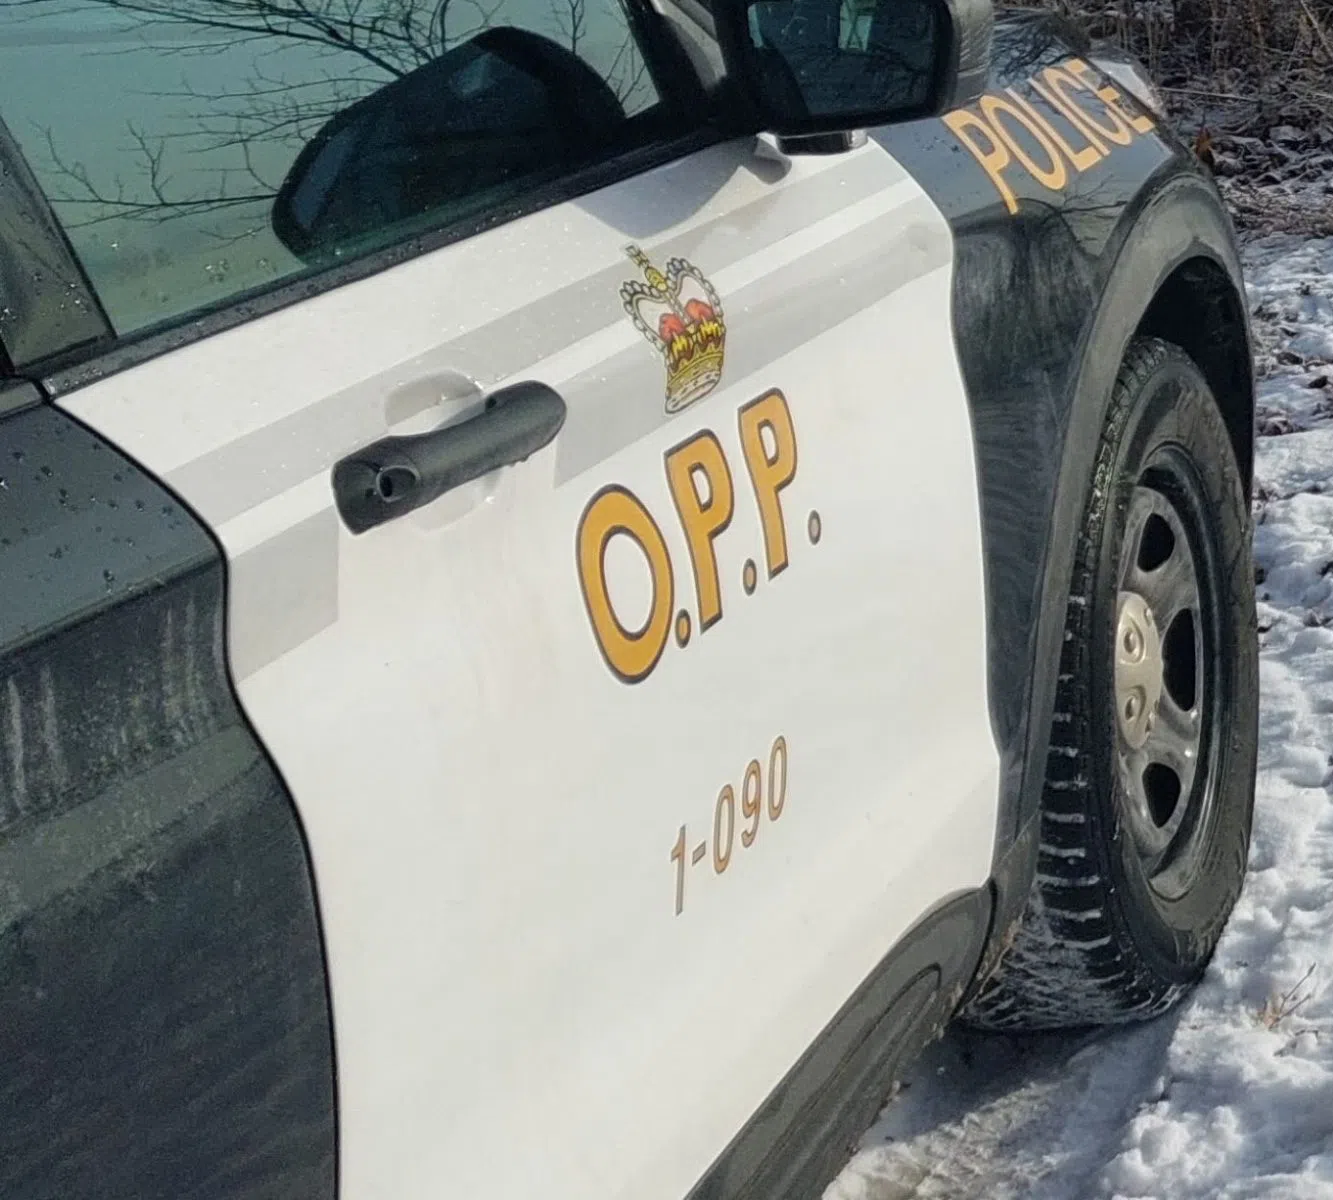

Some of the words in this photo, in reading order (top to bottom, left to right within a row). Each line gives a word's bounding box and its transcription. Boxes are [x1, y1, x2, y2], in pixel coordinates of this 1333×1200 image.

[941, 58, 1155, 215] POLICE
[575, 386, 822, 685] O.P.P.
[670, 735, 788, 916] 1-090
